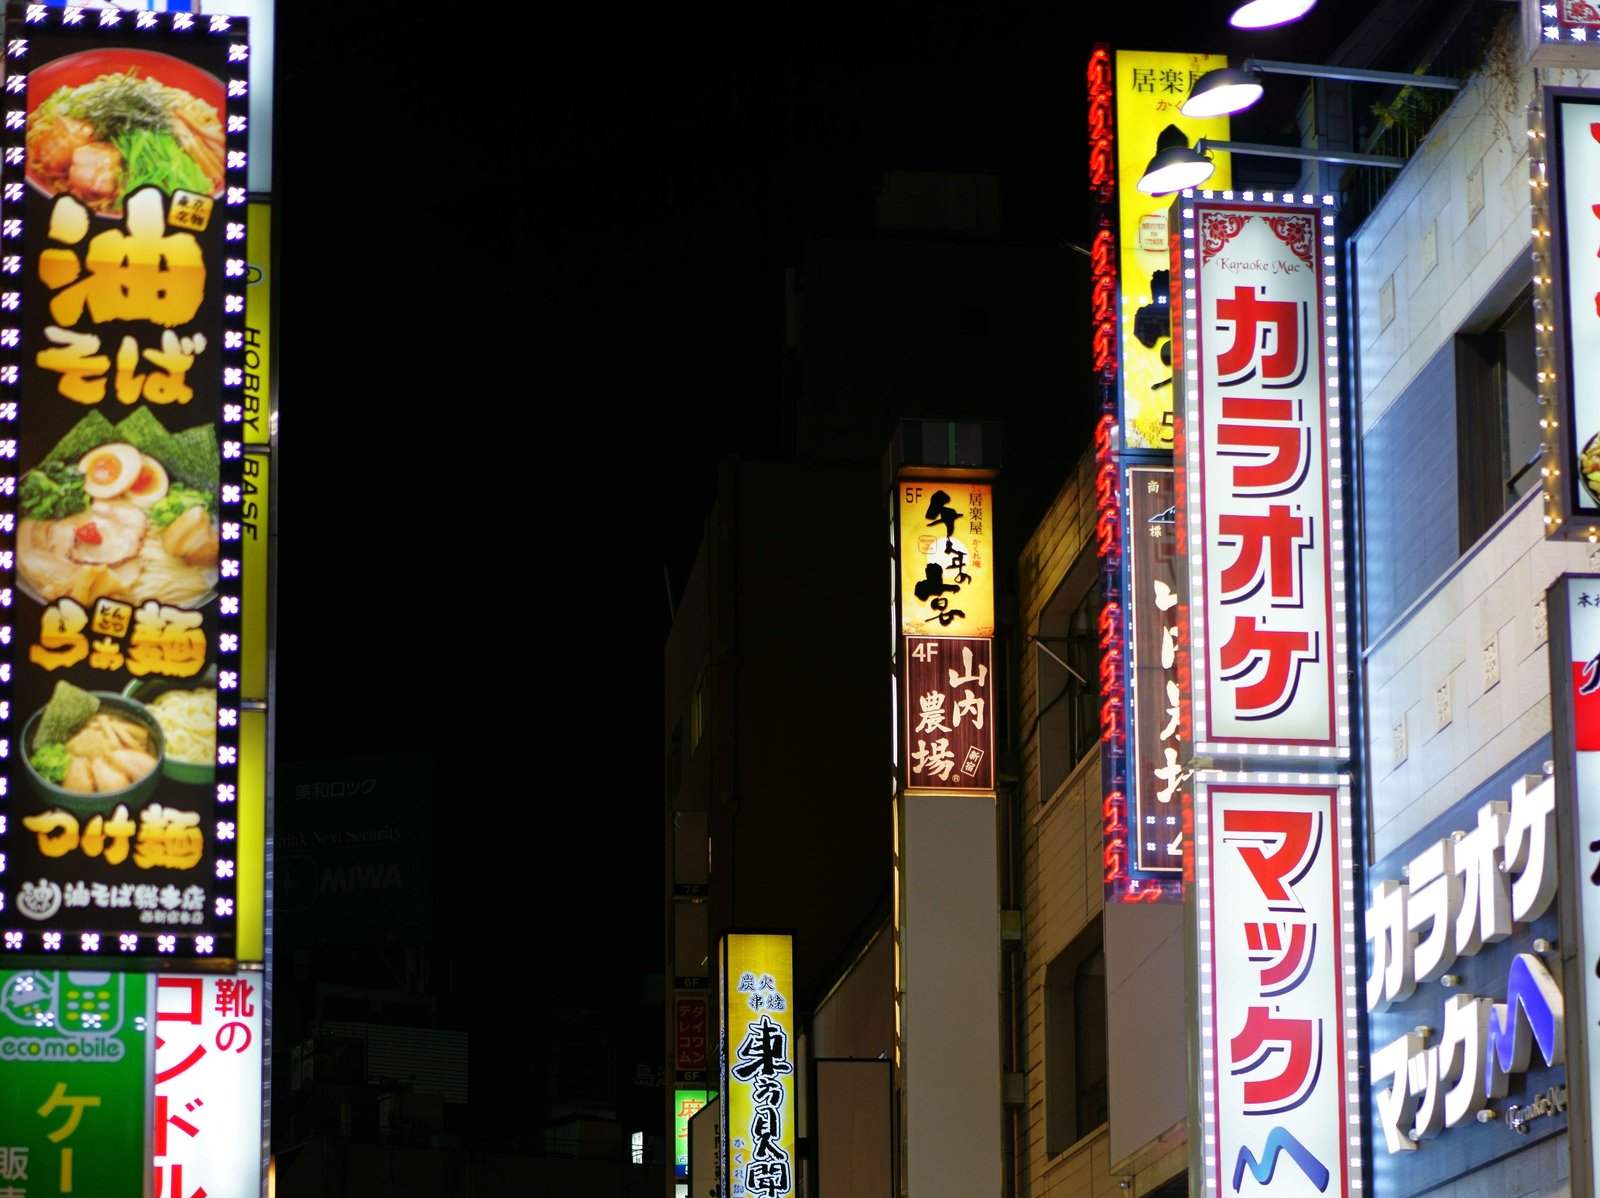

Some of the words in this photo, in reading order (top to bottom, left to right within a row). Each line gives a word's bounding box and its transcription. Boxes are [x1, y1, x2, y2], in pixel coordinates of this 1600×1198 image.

[38, 186, 208, 328] 油
[1216, 257, 1269, 272] Karaoke
[1272, 259, 1300, 275] Mac
[36, 326, 208, 405] そば
[243, 327, 260, 433] HOBBY
[906, 488, 922, 504] 5F
[969, 492, 983, 535] 居楽屋
[1216, 286, 1320, 722] カラオケ
[912, 643, 938, 663] 4F
[949, 646, 988, 731] 山内
[911, 690, 954, 783] 農場
[22, 803, 205, 871] つけ麺
[1365, 773, 1559, 1014] カラオケ
[1223, 809, 1323, 1117] マック
[215, 979, 254, 1053] 靴の
[1369, 993, 1494, 1155] マック
